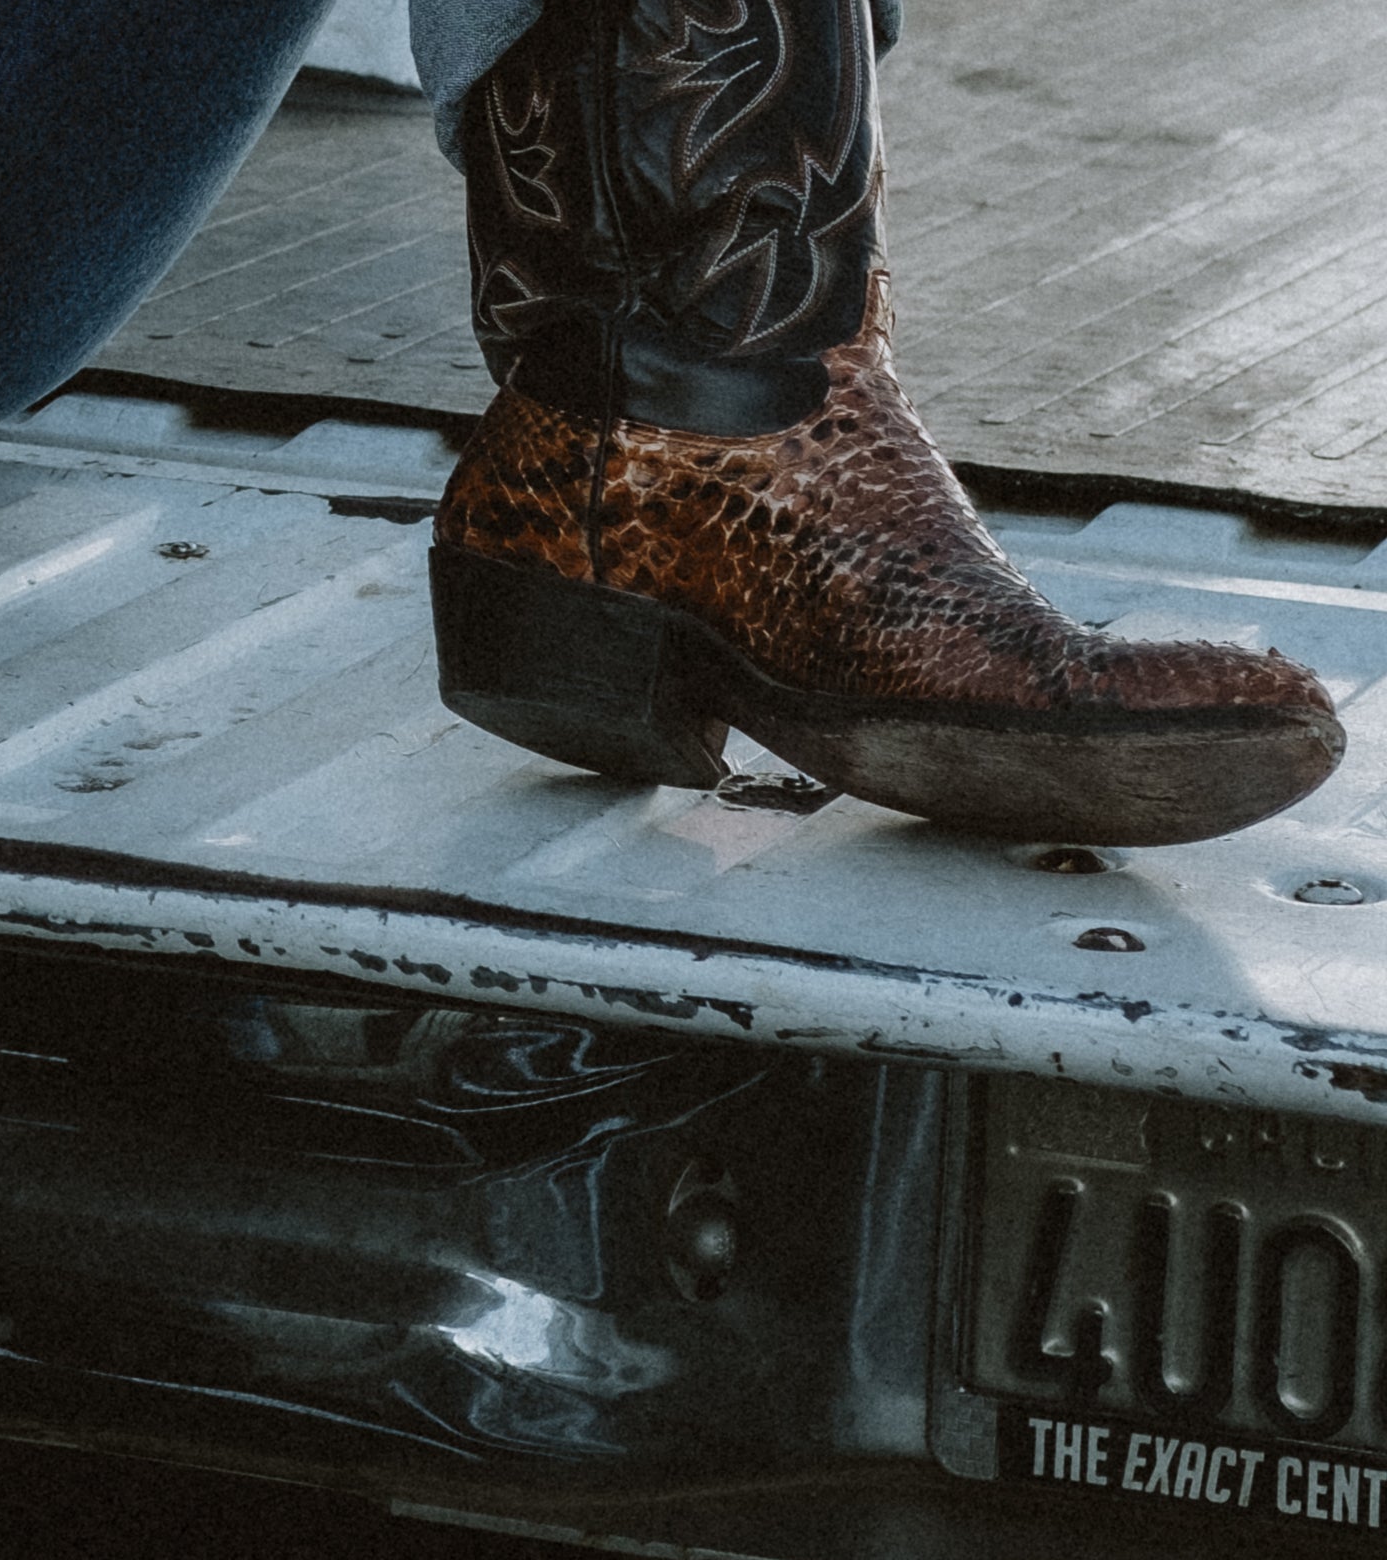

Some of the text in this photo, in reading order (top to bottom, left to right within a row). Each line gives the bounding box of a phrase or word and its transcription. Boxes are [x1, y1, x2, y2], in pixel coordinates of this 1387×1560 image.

[1028, 1417, 1387, 1528] THE EXACT CENT
